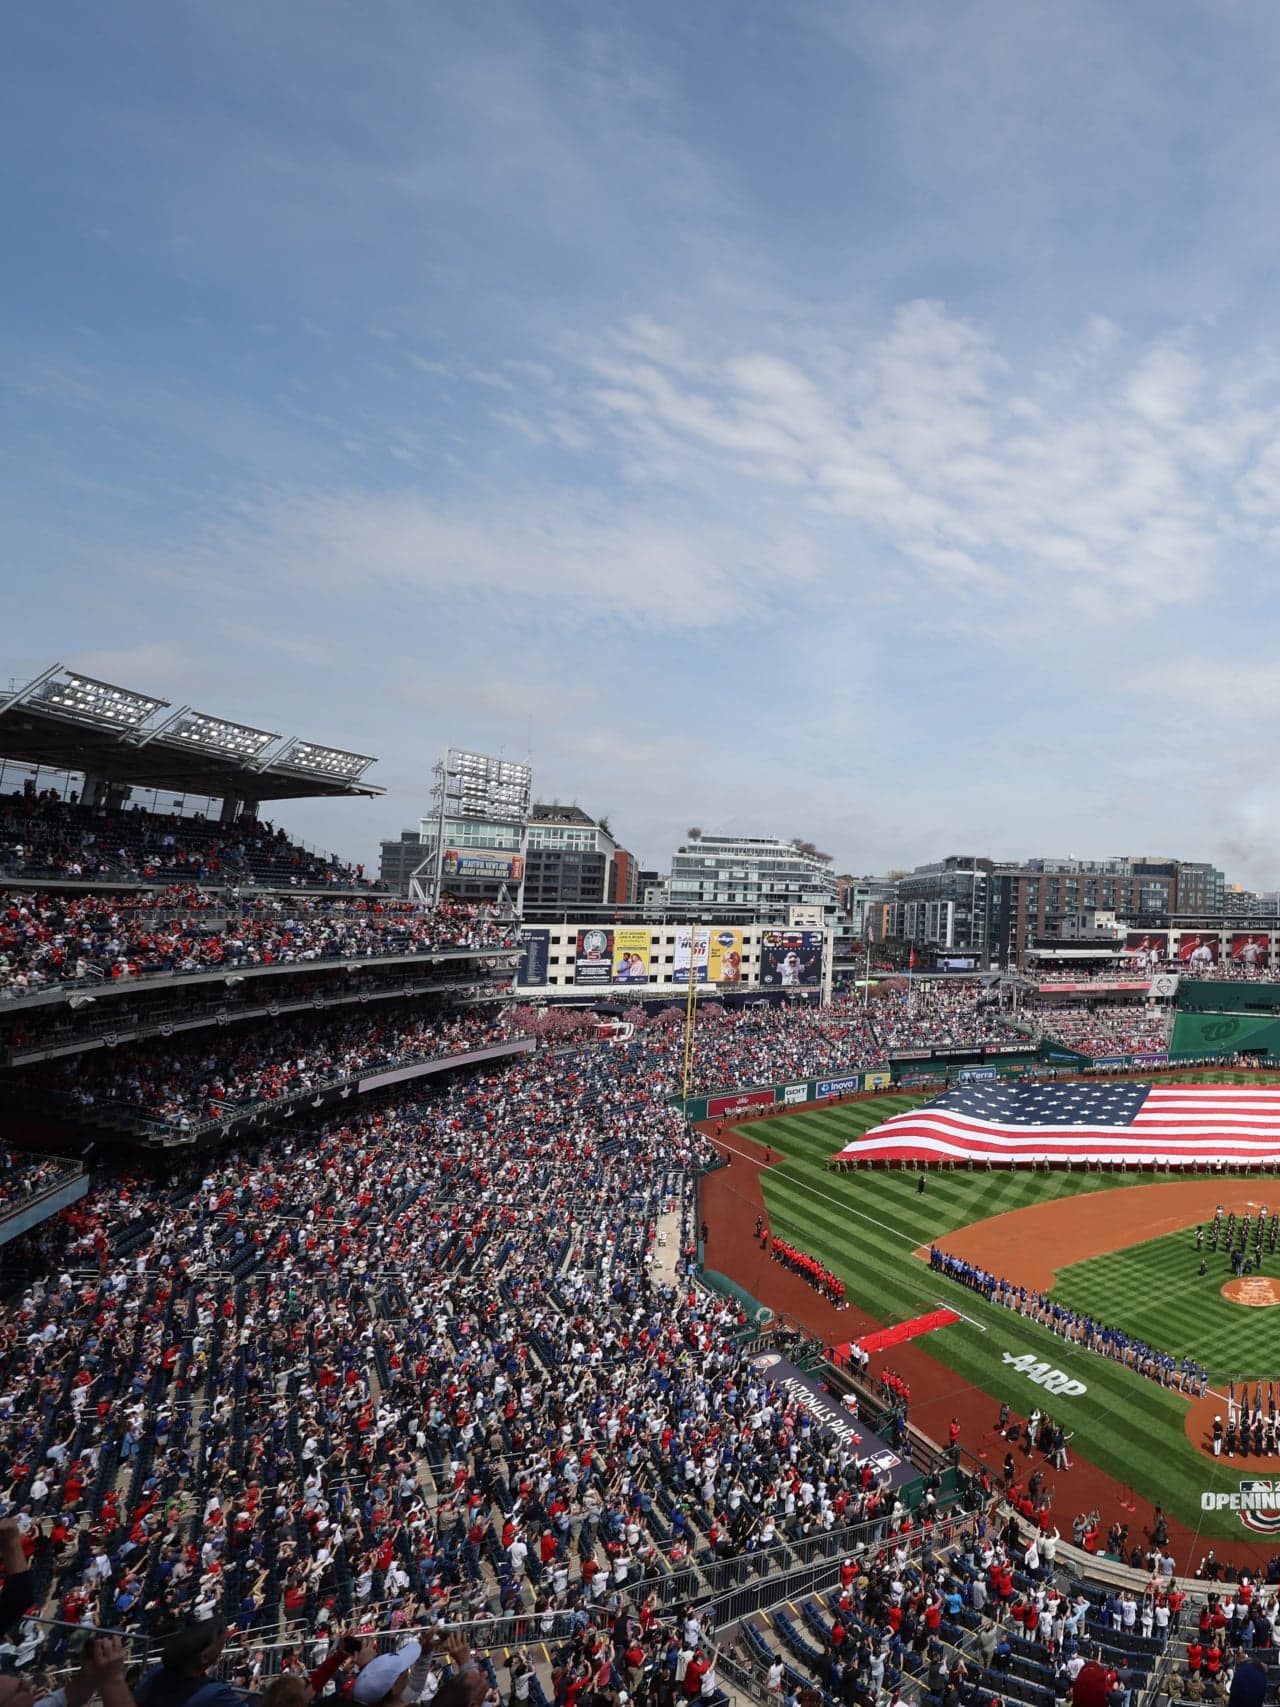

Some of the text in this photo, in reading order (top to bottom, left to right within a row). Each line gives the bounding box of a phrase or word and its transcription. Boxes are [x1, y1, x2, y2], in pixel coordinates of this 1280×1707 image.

[786, 1087, 807, 1096] GDIT
[831, 1080, 854, 1091] Inova
[1001, 1352, 1088, 1397] AARP
[780, 1377, 864, 1445] NATIONALS PARK
